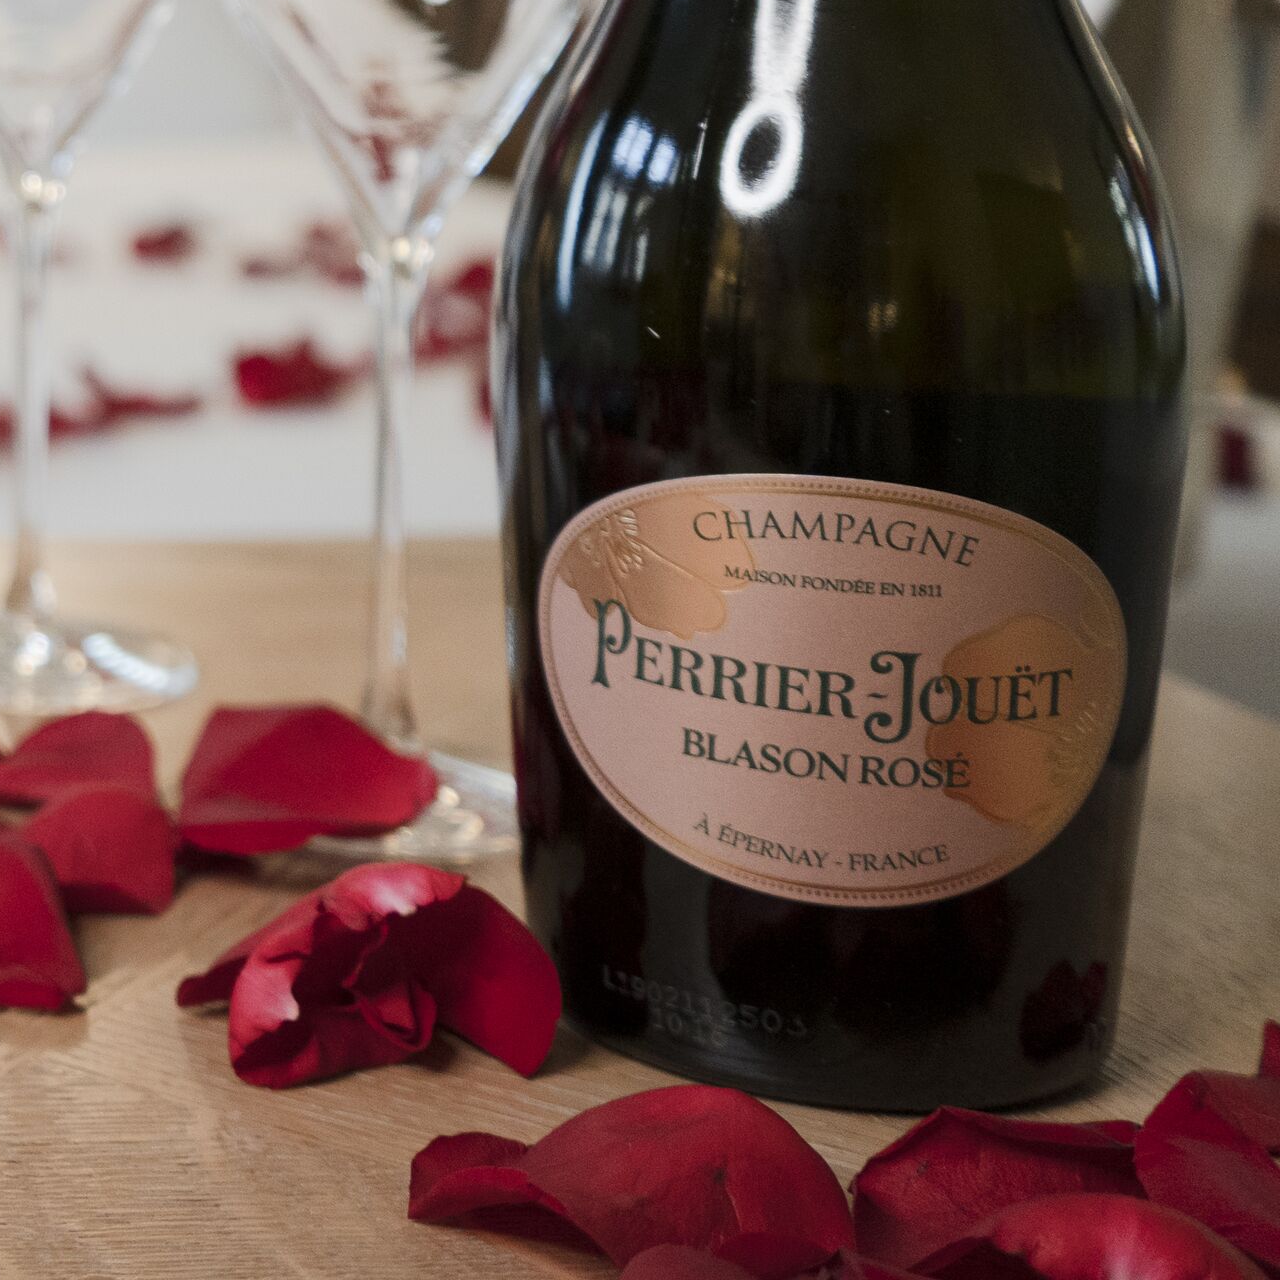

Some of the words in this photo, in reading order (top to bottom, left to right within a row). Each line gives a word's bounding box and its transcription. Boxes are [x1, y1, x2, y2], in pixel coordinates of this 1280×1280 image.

[692, 509, 980, 567] CHAMPAGNE
[724, 565, 796, 588] MAISON
[800, 574, 874, 595] FONDÉE
[880, 583, 905, 597] EN
[911, 583, 943, 598] 1811
[682, 727, 850, 784] BLASON
[859, 751, 972, 789] ROSÉ
[693, 812, 712, 837] À
[717, 822, 830, 868] ÉPERNAY
[848, 844, 952, 872] FRANCE
